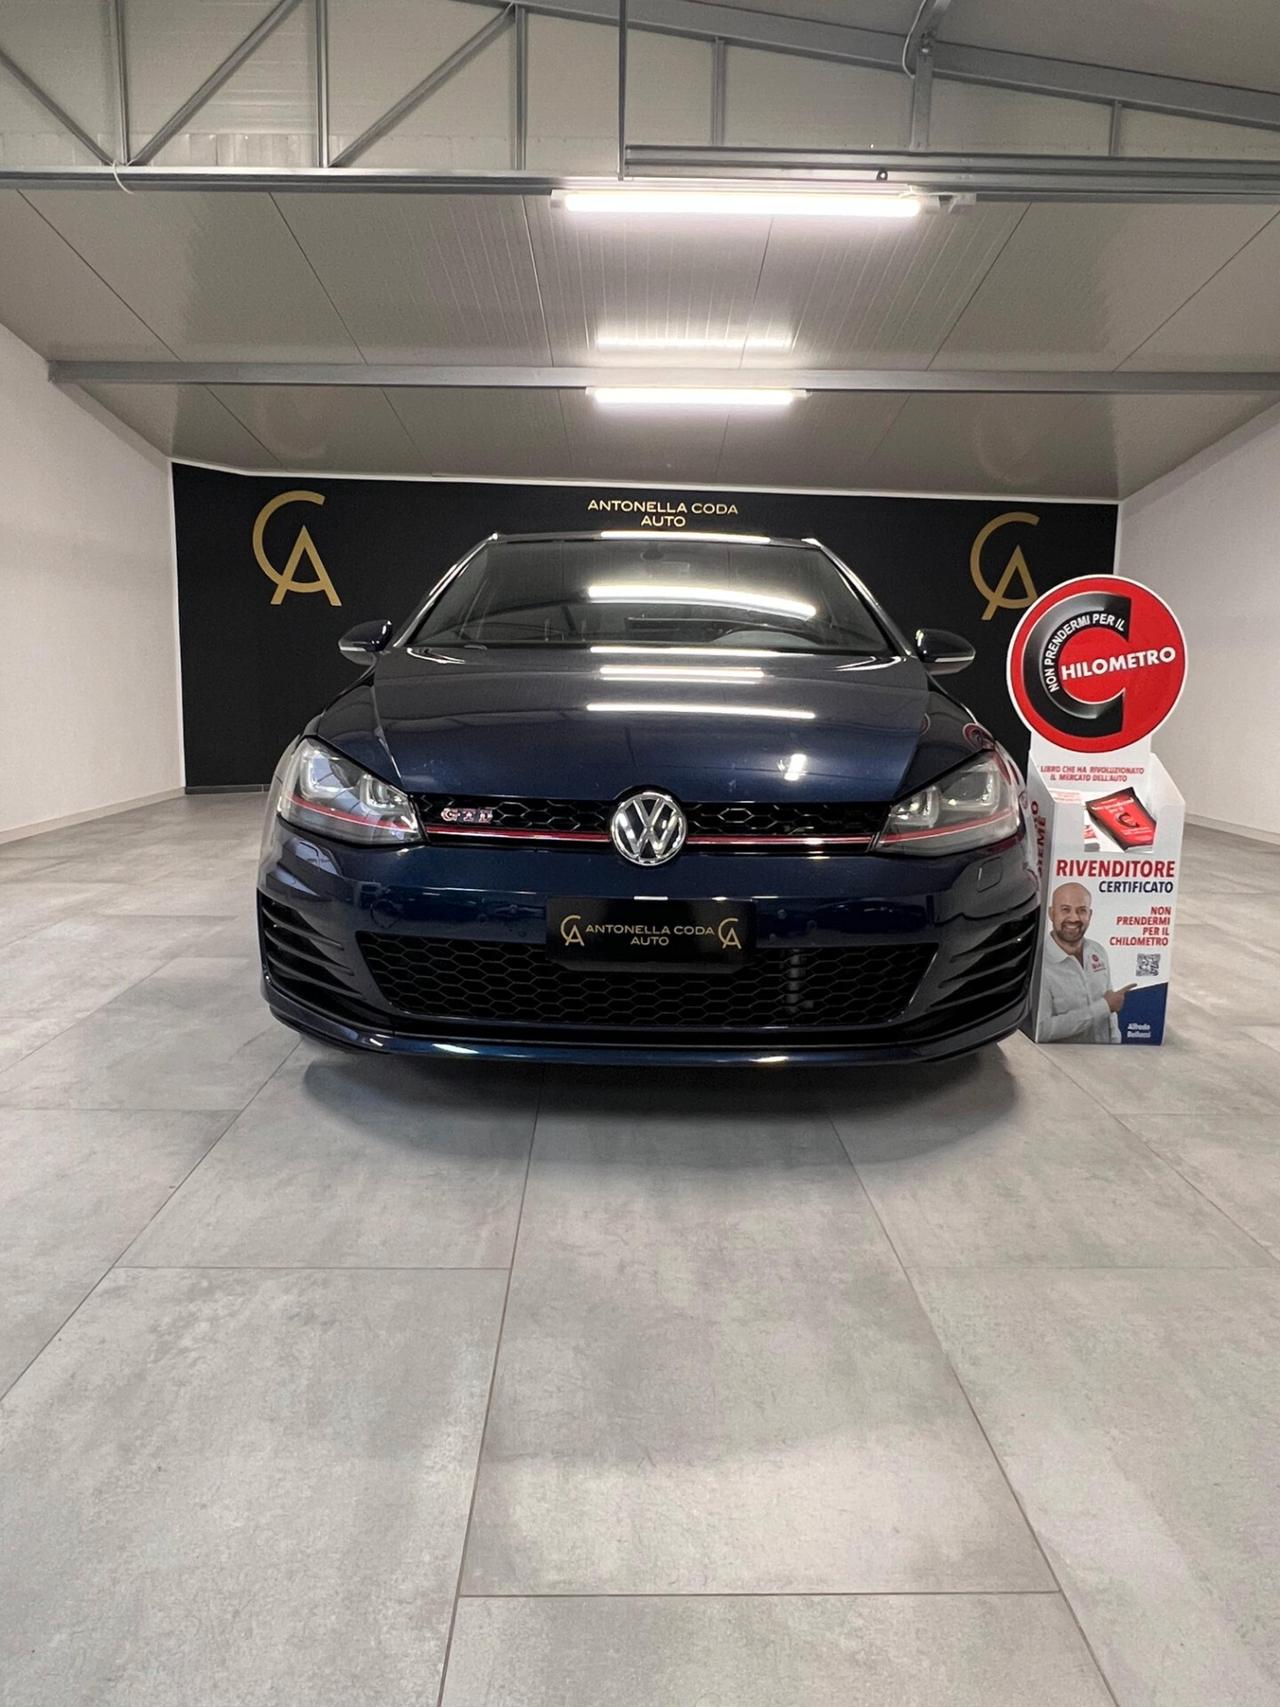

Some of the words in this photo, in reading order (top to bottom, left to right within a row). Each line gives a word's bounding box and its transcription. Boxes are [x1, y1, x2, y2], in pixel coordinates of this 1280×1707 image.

[587, 499, 688, 513] ANTONELLA
[691, 503, 739, 515] CODA
[640, 515, 686, 527] AUTO
[1092, 613, 1115, 627] PER
[1115, 618, 1126, 631] IL
[1044, 614, 1091, 666] PRENDERMI
[1044, 668, 1060, 693] NON
[1040, 765, 1061, 773] LIBRO
[1062, 765, 1075, 773] CHE
[1089, 766, 1145, 775] RIVOLUZIONATO
[1059, 773, 1091, 782] MERCATO
[1056, 859, 1176, 878] RIVENDITORE
[1099, 880, 1174, 893] CERTIFICATO
[1150, 906, 1172, 916] NON
[1116, 916, 1171, 926] PRENDERMI
[585, 924, 671, 935] ANTONELLA
[673, 925, 716, 935] CODA
[1142, 926, 1160, 936] PER
[1161, 927, 1170, 936] IL
[630, 936, 670, 946] AUTO
[1109, 936, 1169, 946] CHILOMETRO
